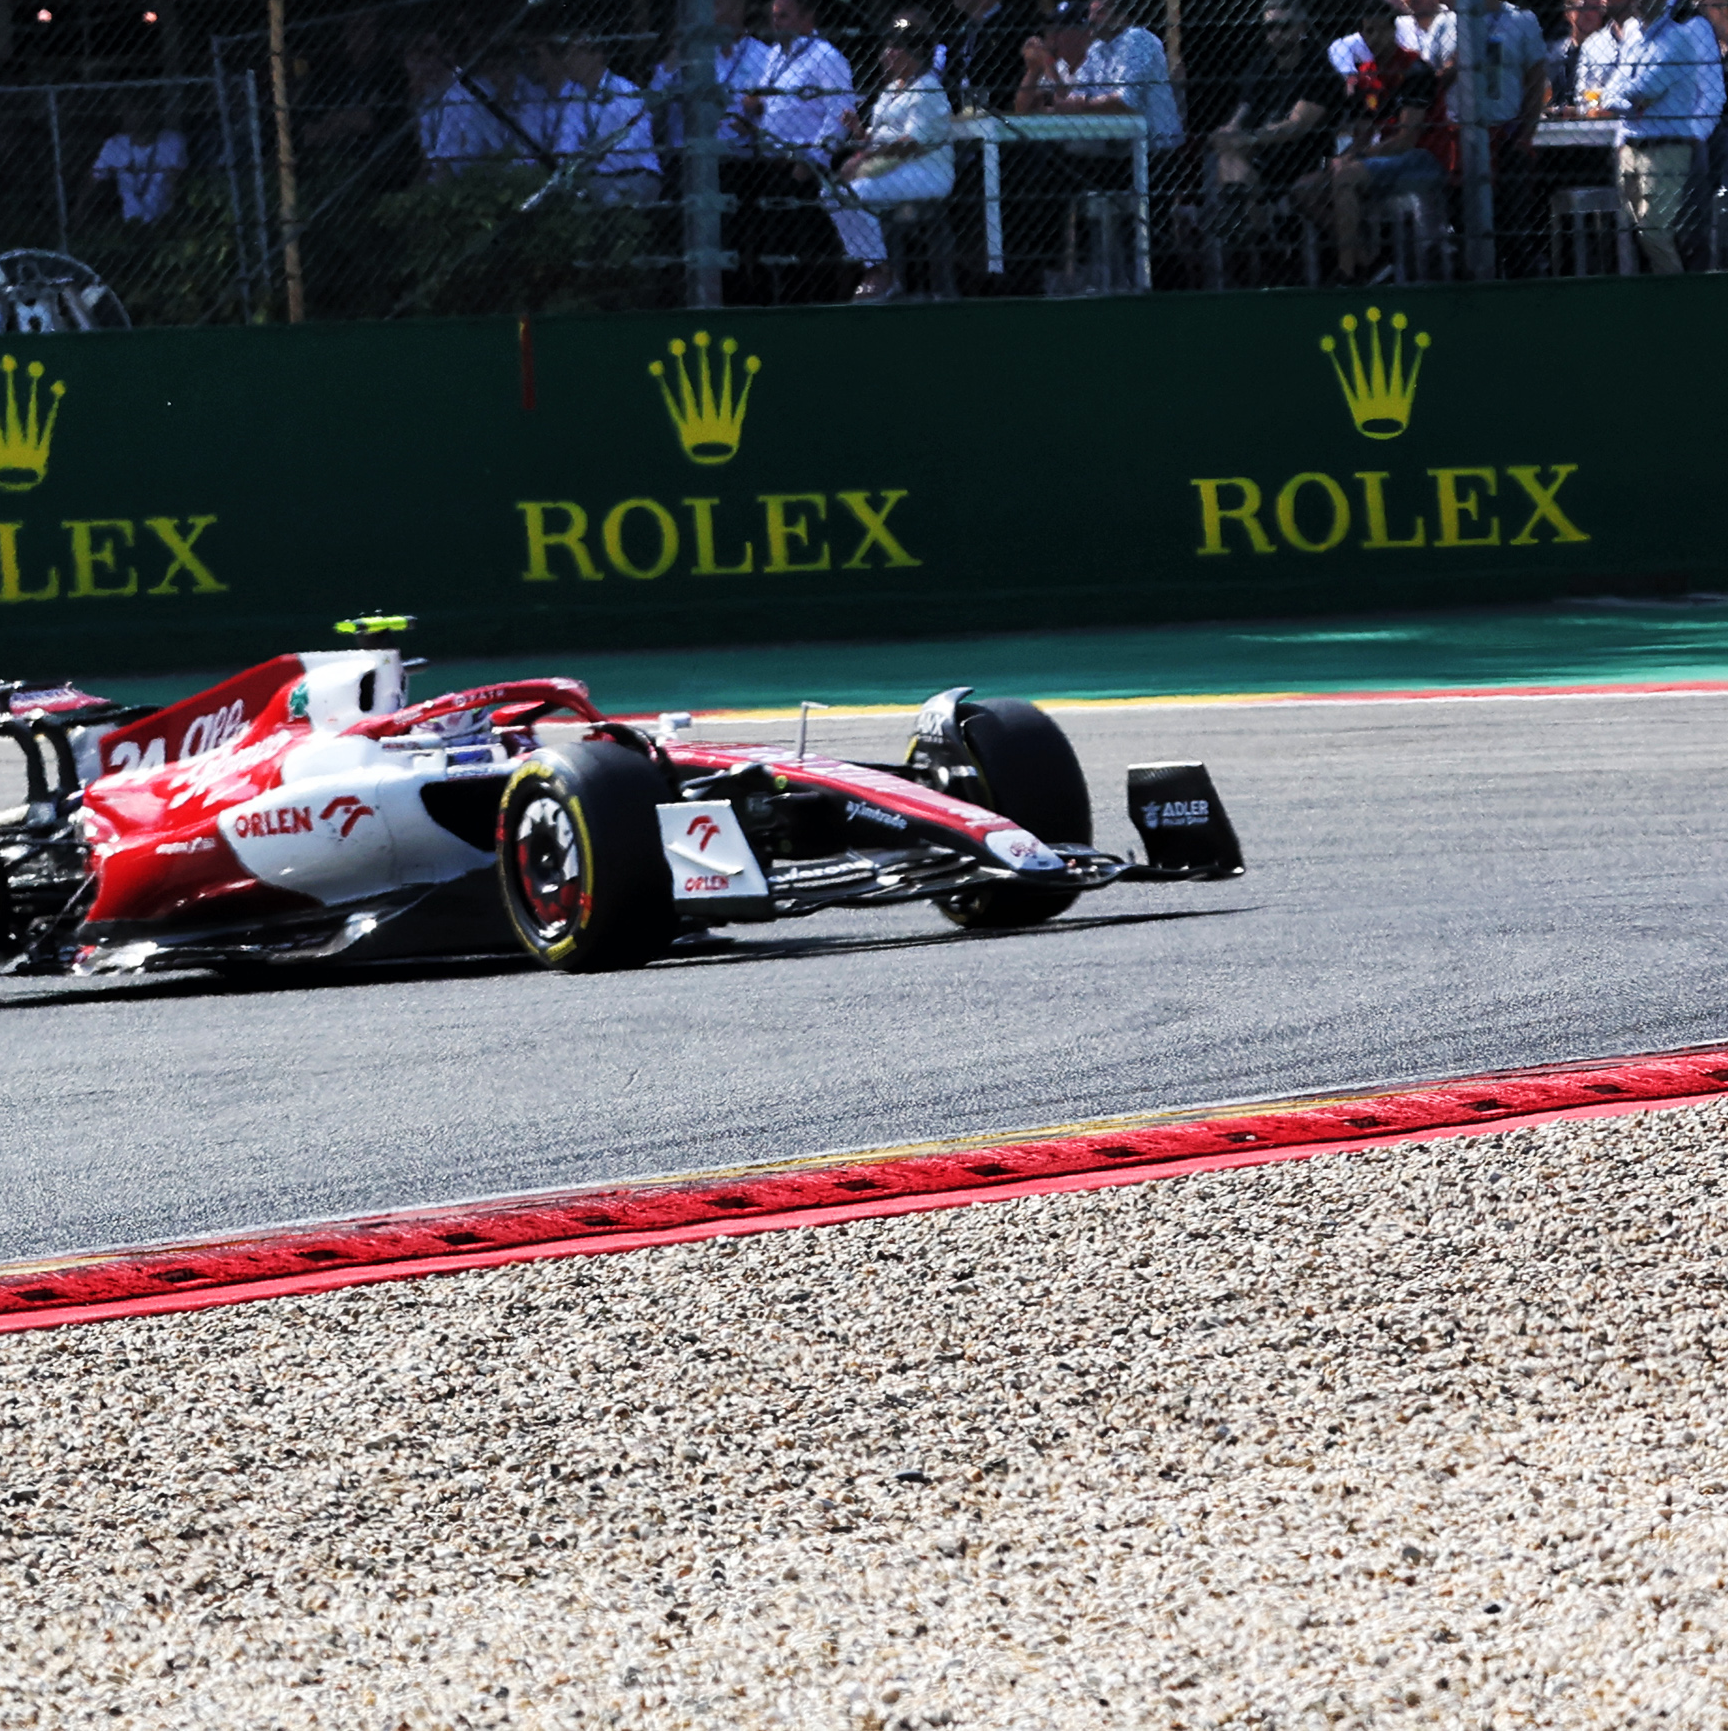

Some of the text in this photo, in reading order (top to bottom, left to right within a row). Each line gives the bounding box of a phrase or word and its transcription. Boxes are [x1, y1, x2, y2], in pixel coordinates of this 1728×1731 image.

[1191, 465, 1587, 553] ROLEX
[518, 489, 919, 578] ROLEX
[235, 806, 313, 838] ORLEN
[1162, 800, 1209, 817] ADLER
[685, 875, 729, 892] ORLEN
